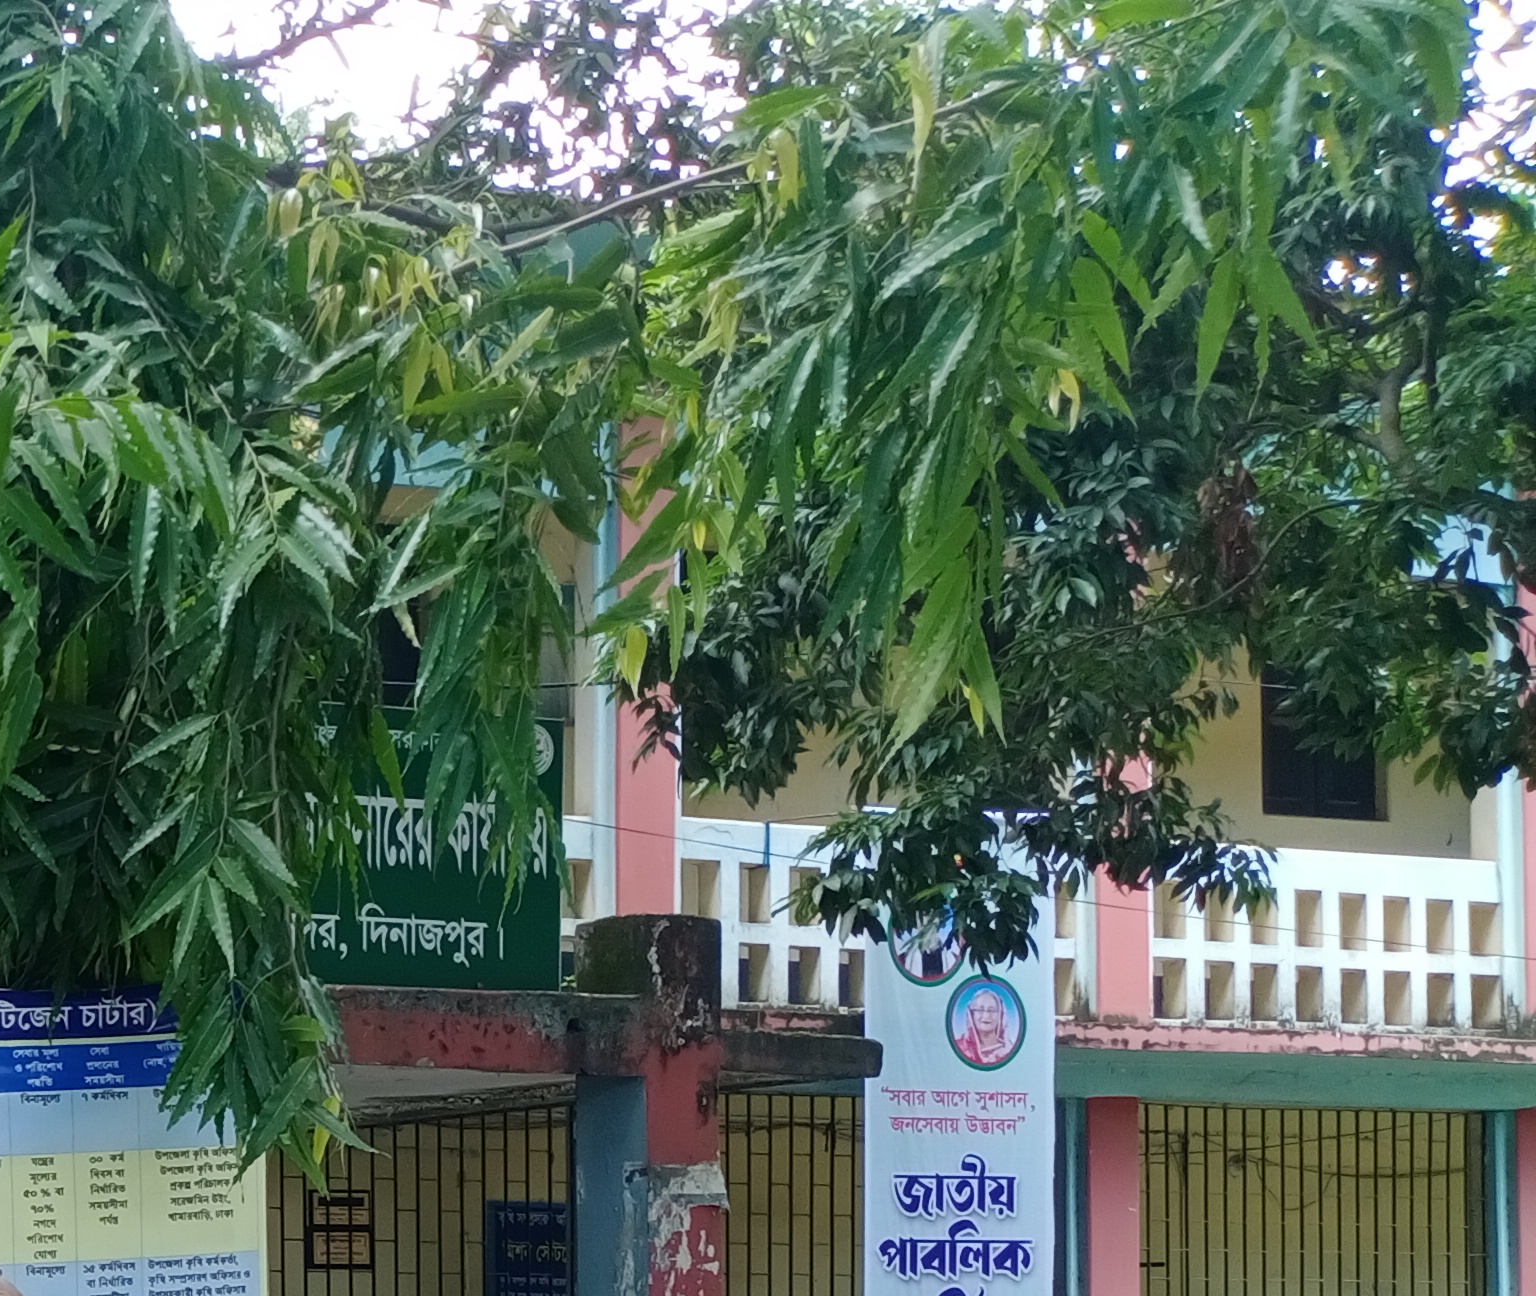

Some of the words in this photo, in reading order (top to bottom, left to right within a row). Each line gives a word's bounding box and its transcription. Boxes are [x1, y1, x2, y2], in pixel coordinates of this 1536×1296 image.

[79, 998, 158, 1034] চার্টার)
[889, 1115, 959, 1135] জনসেবায়
[965, 1115, 1026, 1136] উদ্ভাবন”
[892, 1153, 1017, 1219] জাতীয়
[878, 1219, 1033, 1281] পাবলিক
